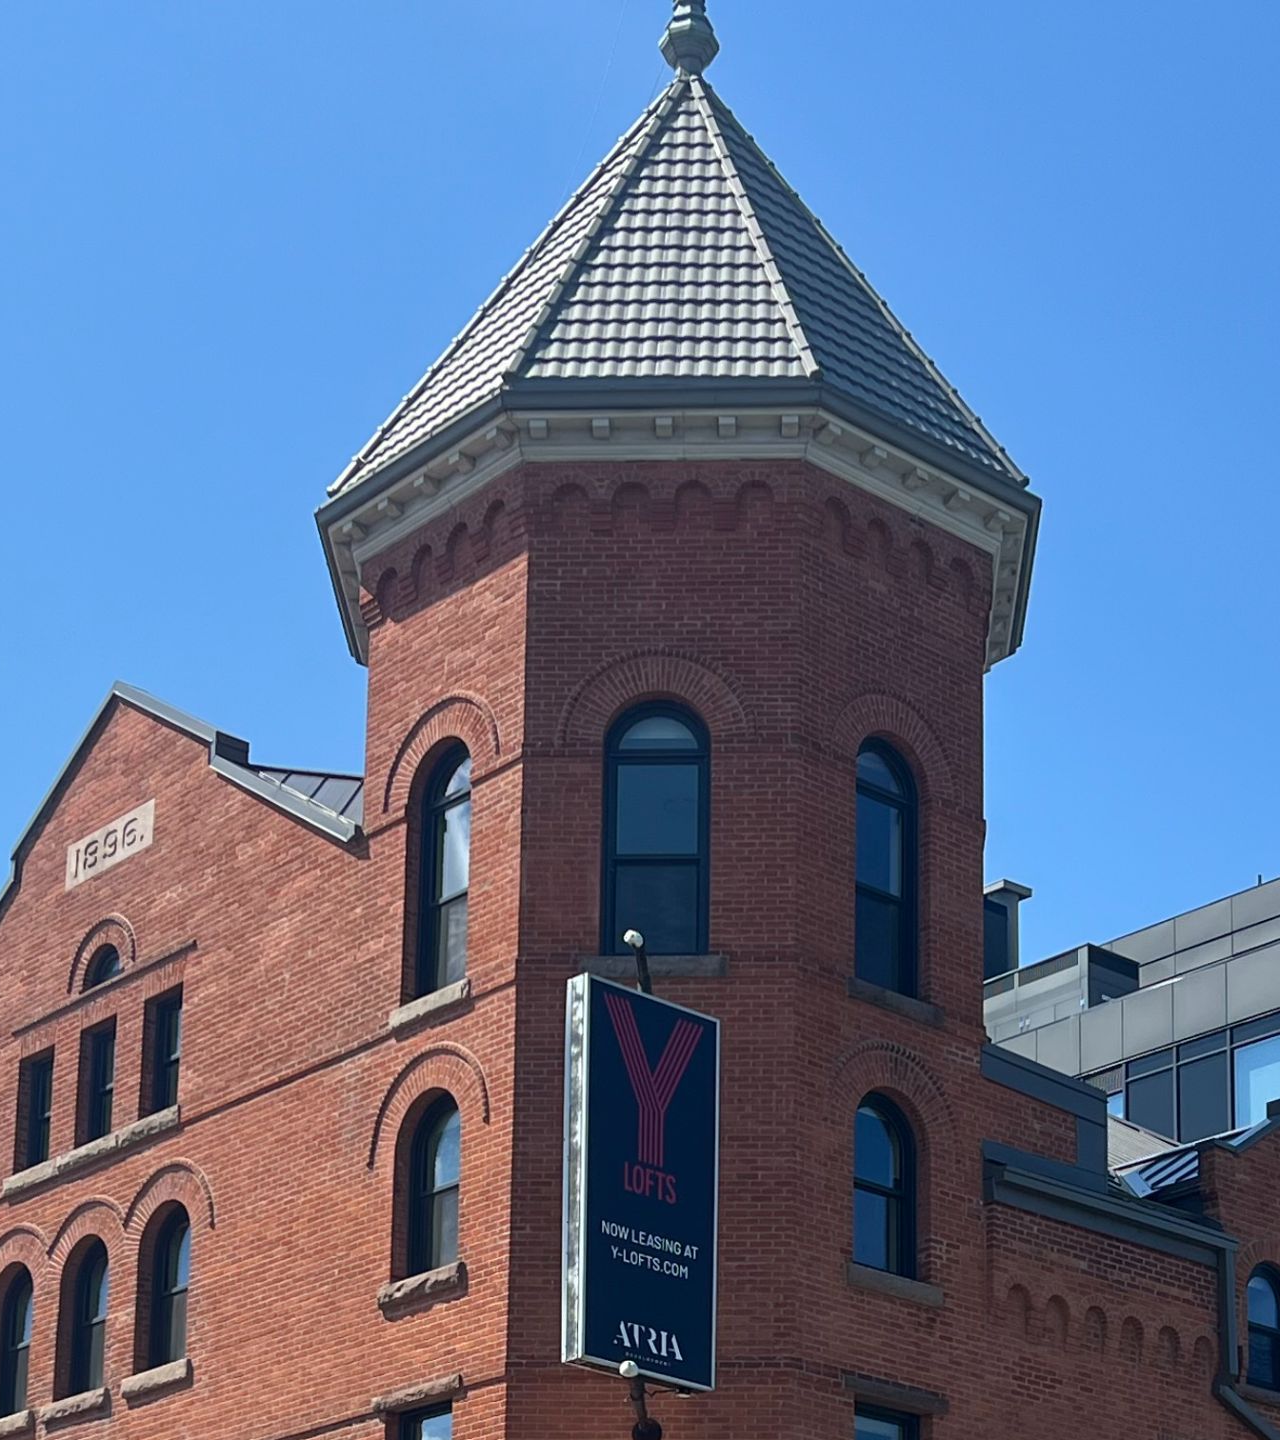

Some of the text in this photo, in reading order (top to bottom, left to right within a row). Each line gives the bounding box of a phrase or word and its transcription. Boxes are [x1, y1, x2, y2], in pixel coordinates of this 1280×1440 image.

[604, 990, 704, 1168] Y
[624, 1161, 677, 1204] LOFTS
[601, 1219, 699, 1260] NOW LEASING AT
[611, 1245, 689, 1280] Y-LOFTS.COM
[613, 1320, 683, 1361] ATRIA
